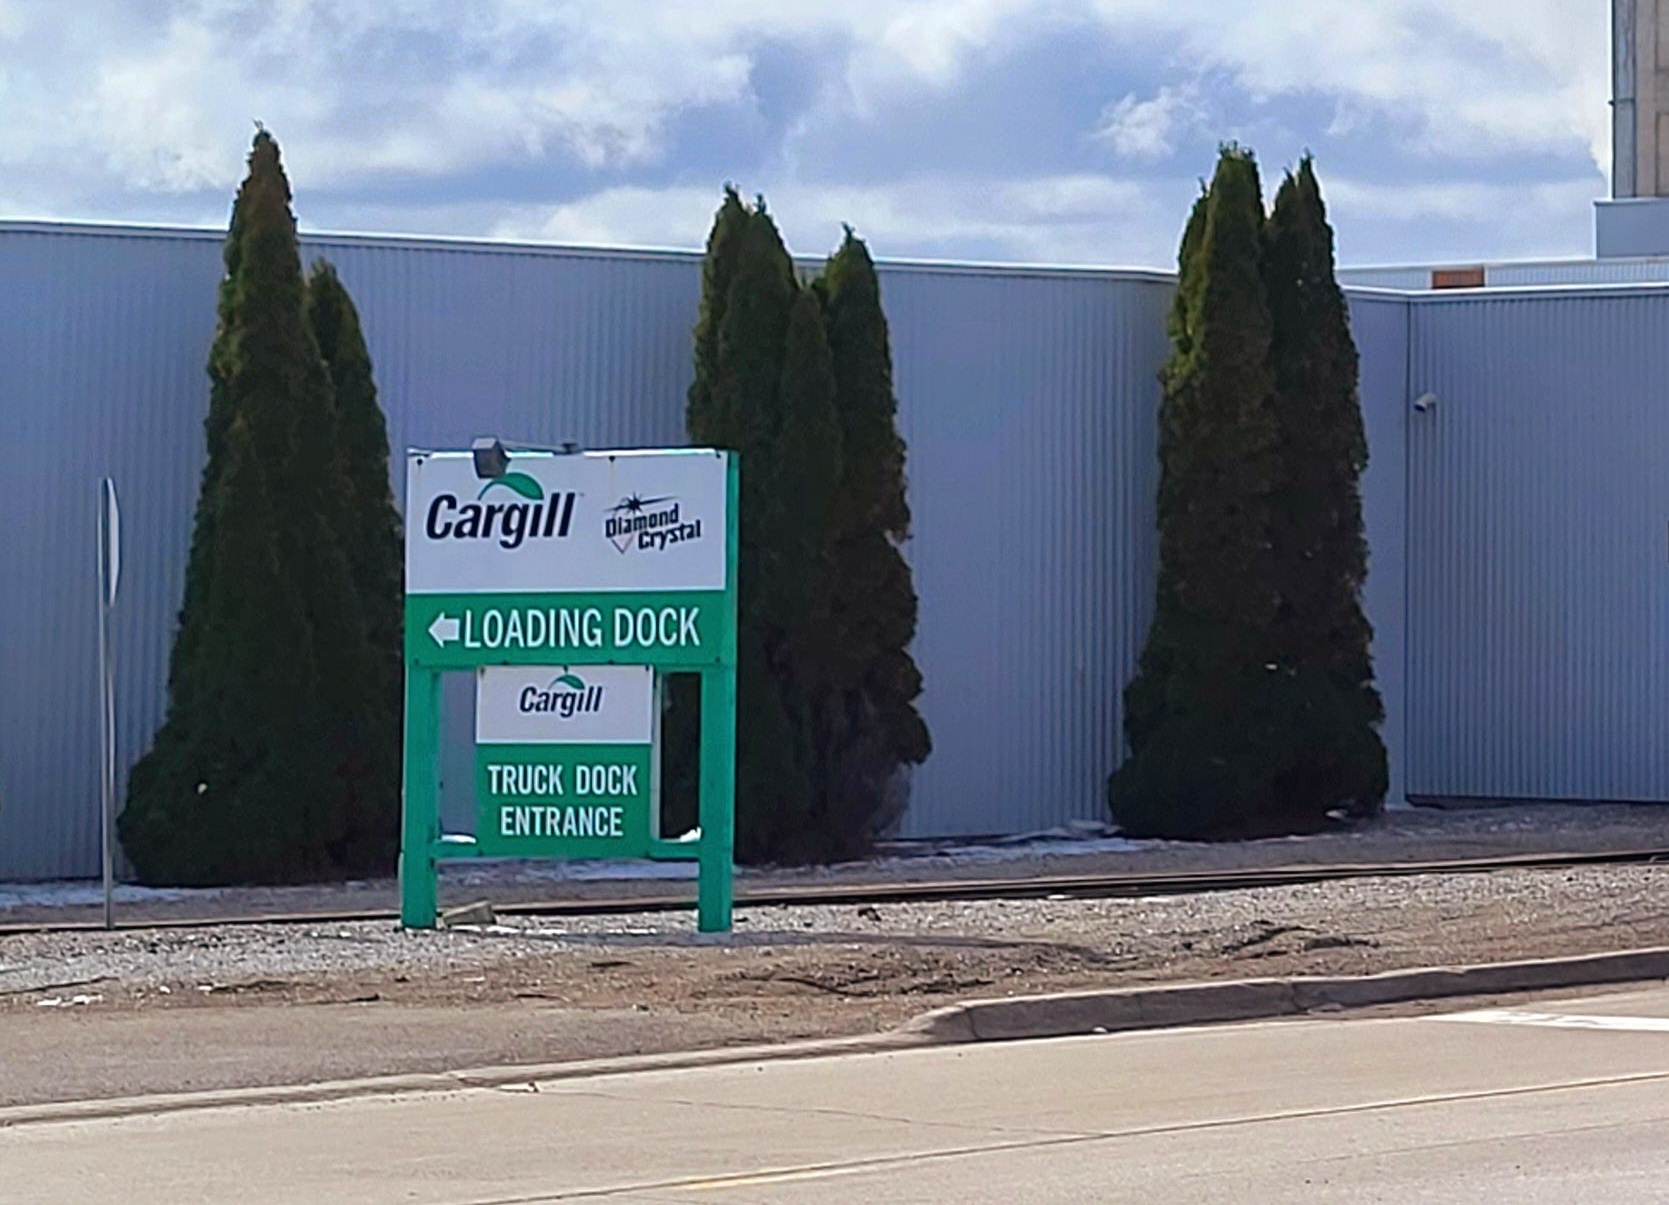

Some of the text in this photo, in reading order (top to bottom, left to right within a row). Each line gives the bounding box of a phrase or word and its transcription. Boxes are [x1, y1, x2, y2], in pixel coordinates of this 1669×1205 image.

[426, 493, 575, 549] Cargill
[605, 503, 679, 539] Diamond
[638, 520, 701, 551] Crystal
[464, 607, 700, 648] LOADING DOCK
[519, 685, 602, 717] Cargill
[488, 764, 637, 795] TRUCK DOCK
[501, 805, 623, 837] ENTRANCE
